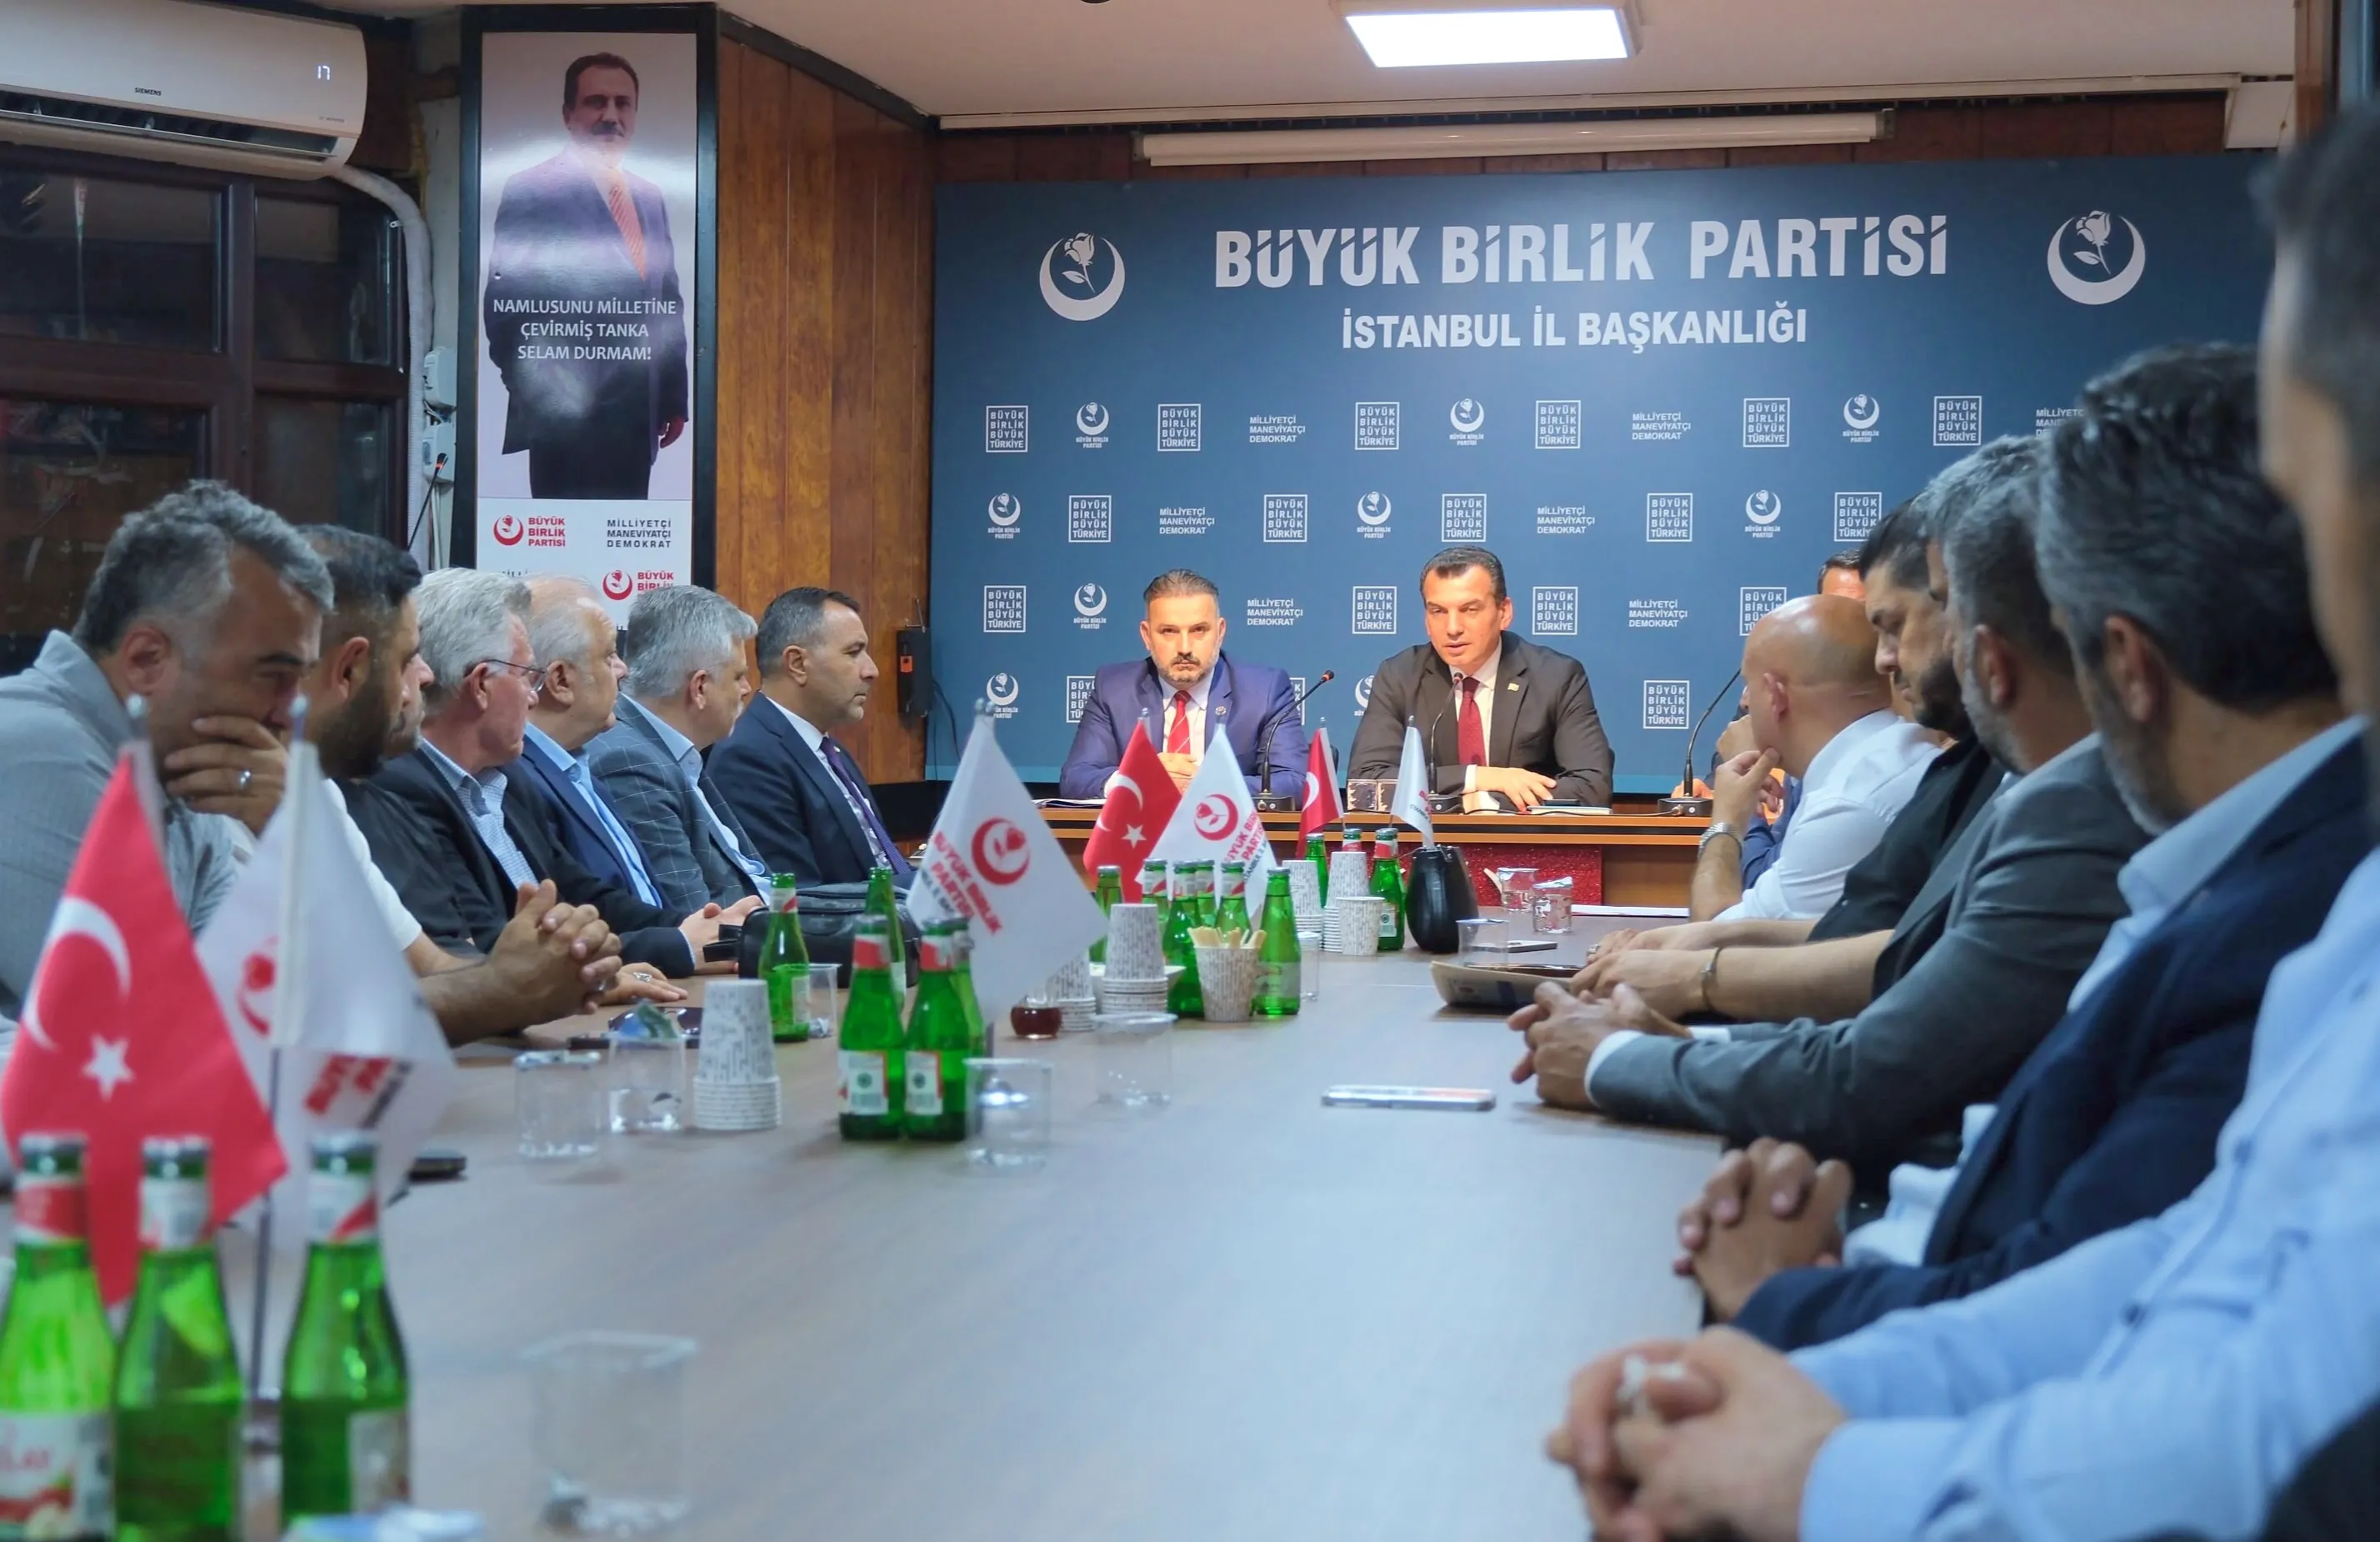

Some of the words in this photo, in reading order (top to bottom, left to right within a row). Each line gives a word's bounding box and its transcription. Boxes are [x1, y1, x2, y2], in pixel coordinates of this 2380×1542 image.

[134, 87, 162, 97] SIEMENS
[1216, 227, 1420, 288] BÜYÜK
[1442, 223, 1654, 283] BİRLİK
[1689, 215, 1946, 279] PARTİSİ
[493, 299, 592, 313] NAMLUSUNU
[598, 298, 677, 314] MİLLETİNE
[521, 320, 592, 341] ÇEVİRMİŞ
[597, 323, 649, 337] TANKA
[1343, 308, 1521, 348] İSTANBUL
[1534, 306, 1565, 346] İL
[1578, 302, 1805, 353] BAŞKANLIĞI
[518, 345, 570, 359] SELAM
[574, 347, 652, 360] DURMAM!
[1541, 405, 1576, 414] BÜYÜK
[1748, 403, 1785, 412] BÜYÜK
[1939, 401, 1977, 410] BÜYÜK
[991, 410, 1023, 419] BÜYÜK
[1162, 408, 1196, 418] BÜYÜK
[1360, 407, 1395, 416] BÜYÜK
[1939, 411, 1977, 420] BİRLİK
[1162, 418, 1196, 427] BİRLİK
[1250, 415, 1296, 425] MİLLİYETÇİ
[1360, 416, 1395, 426] BİRLİK
[1541, 414, 1576, 424] BİRLİK
[1632, 412, 1681, 423] MİLLİYETÇİ
[1748, 413, 1785, 422] BİRLİK
[991, 419, 1023, 428] BİRLİK
[1632, 422, 1691, 432] MANEVİYATÇI
[1748, 423, 1784, 433] BÜYÜK
[1938, 421, 1976, 431] BÜYÜK
[991, 429, 1023, 438] BÜYÜK
[1162, 428, 1196, 437] BÜYÜK
[1250, 424, 1305, 435] MANEVİYATÇI
[1360, 426, 1394, 436] BÜYÜK
[1540, 424, 1576, 434] BÜYÜK
[1250, 434, 1296, 443] DEMOKRAT
[1360, 436, 1395, 445] TÜRKİYE
[1540, 434, 1576, 444] TÜRKİYE
[1632, 432, 1680, 440] DEMOKRAT
[1748, 433, 1784, 443] TÜRKİYE
[1938, 431, 1976, 441] TÜRKİYE
[990, 438, 1023, 448] TÜRKİYE
[1162, 437, 1196, 447] TÜRKİYE
[1073, 500, 1107, 509] BÜYÜK
[1268, 499, 1302, 508] BÜYÜK
[1447, 498, 1482, 508] BÜYÜK
[1652, 498, 1688, 507] BÜYÜK
[1840, 497, 1877, 506] BÜYÜK
[1073, 509, 1107, 518] BİRLİK
[1160, 507, 1205, 517] MİLLİYETÇİ
[1268, 508, 1302, 518] BİRLİK
[1447, 508, 1482, 518] BİRLİK
[1538, 506, 1585, 516] MİLLİYETÇİ
[1652, 508, 1688, 517] BİRLİK
[1839, 507, 1877, 517] BİRLİK
[528, 516, 565, 525] BÜYÜK
[607, 518, 671, 529] MİLLİYETÇİ
[1073, 518, 1107, 528] BÜYÜK
[1160, 516, 1214, 527] MANEVİYATÇI
[1268, 518, 1302, 528] BÜYÜK
[1447, 518, 1482, 528] BÜYÜK
[1538, 515, 1595, 526] MANEVİYATÇI
[1652, 518, 1688, 527] BÜYÜK
[1839, 517, 1877, 527] BÜYÜK
[528, 527, 565, 536] BİRLİK
[607, 528, 671, 538] MANEVİYATÇI
[1073, 528, 1107, 538] TÜRKİYE
[1160, 526, 1205, 534] DEMOKRAT
[1268, 528, 1302, 538] TÜRKİYE
[1447, 528, 1482, 537] TÜRKİYE
[1538, 525, 1586, 533] DEMOKRAT
[1651, 527, 1688, 537] TÜRKİYE
[1838, 527, 1874, 537] TÜRKİY
[528, 538, 565, 547] PARTİSİ
[638, 570, 673, 580] BÜYÜK
[988, 590, 1022, 599] BÜYÜK
[1358, 591, 1392, 600] BÜYÜK
[1538, 592, 1573, 601] BÜYÜK
[1745, 592, 1782, 602] BÜYÜK
[988, 599, 1022, 608] BİRLİK
[1248, 598, 1293, 608] MİLLİYETÇİ
[1358, 600, 1392, 610] BİRLİK
[1538, 601, 1572, 611] BİRLİK
[1629, 599, 1678, 609] MİLLİYETÇİ
[988, 608, 1022, 618] BÜYÜK
[1248, 608, 1302, 618] MANEVİYATÇI
[1358, 610, 1392, 619] BÜYÜK
[1538, 611, 1572, 621] BÜYÜK
[1629, 608, 1688, 619] MANEVİYATÇI
[988, 618, 1022, 628] TÜRKİYE
[1248, 617, 1294, 625] DEMOKRAT
[1357, 619, 1392, 629] TÜRKİYE
[1537, 621, 1572, 630] TÜRKİYE
[1629, 618, 1678, 627] DEMOKRAT
[1648, 685, 1684, 694] BÜYÜK
[1648, 694, 1684, 704] BİRLİK
[1648, 704, 1684, 714] BÜYÜK
[1648, 714, 1684, 724] TÜRKİYE
